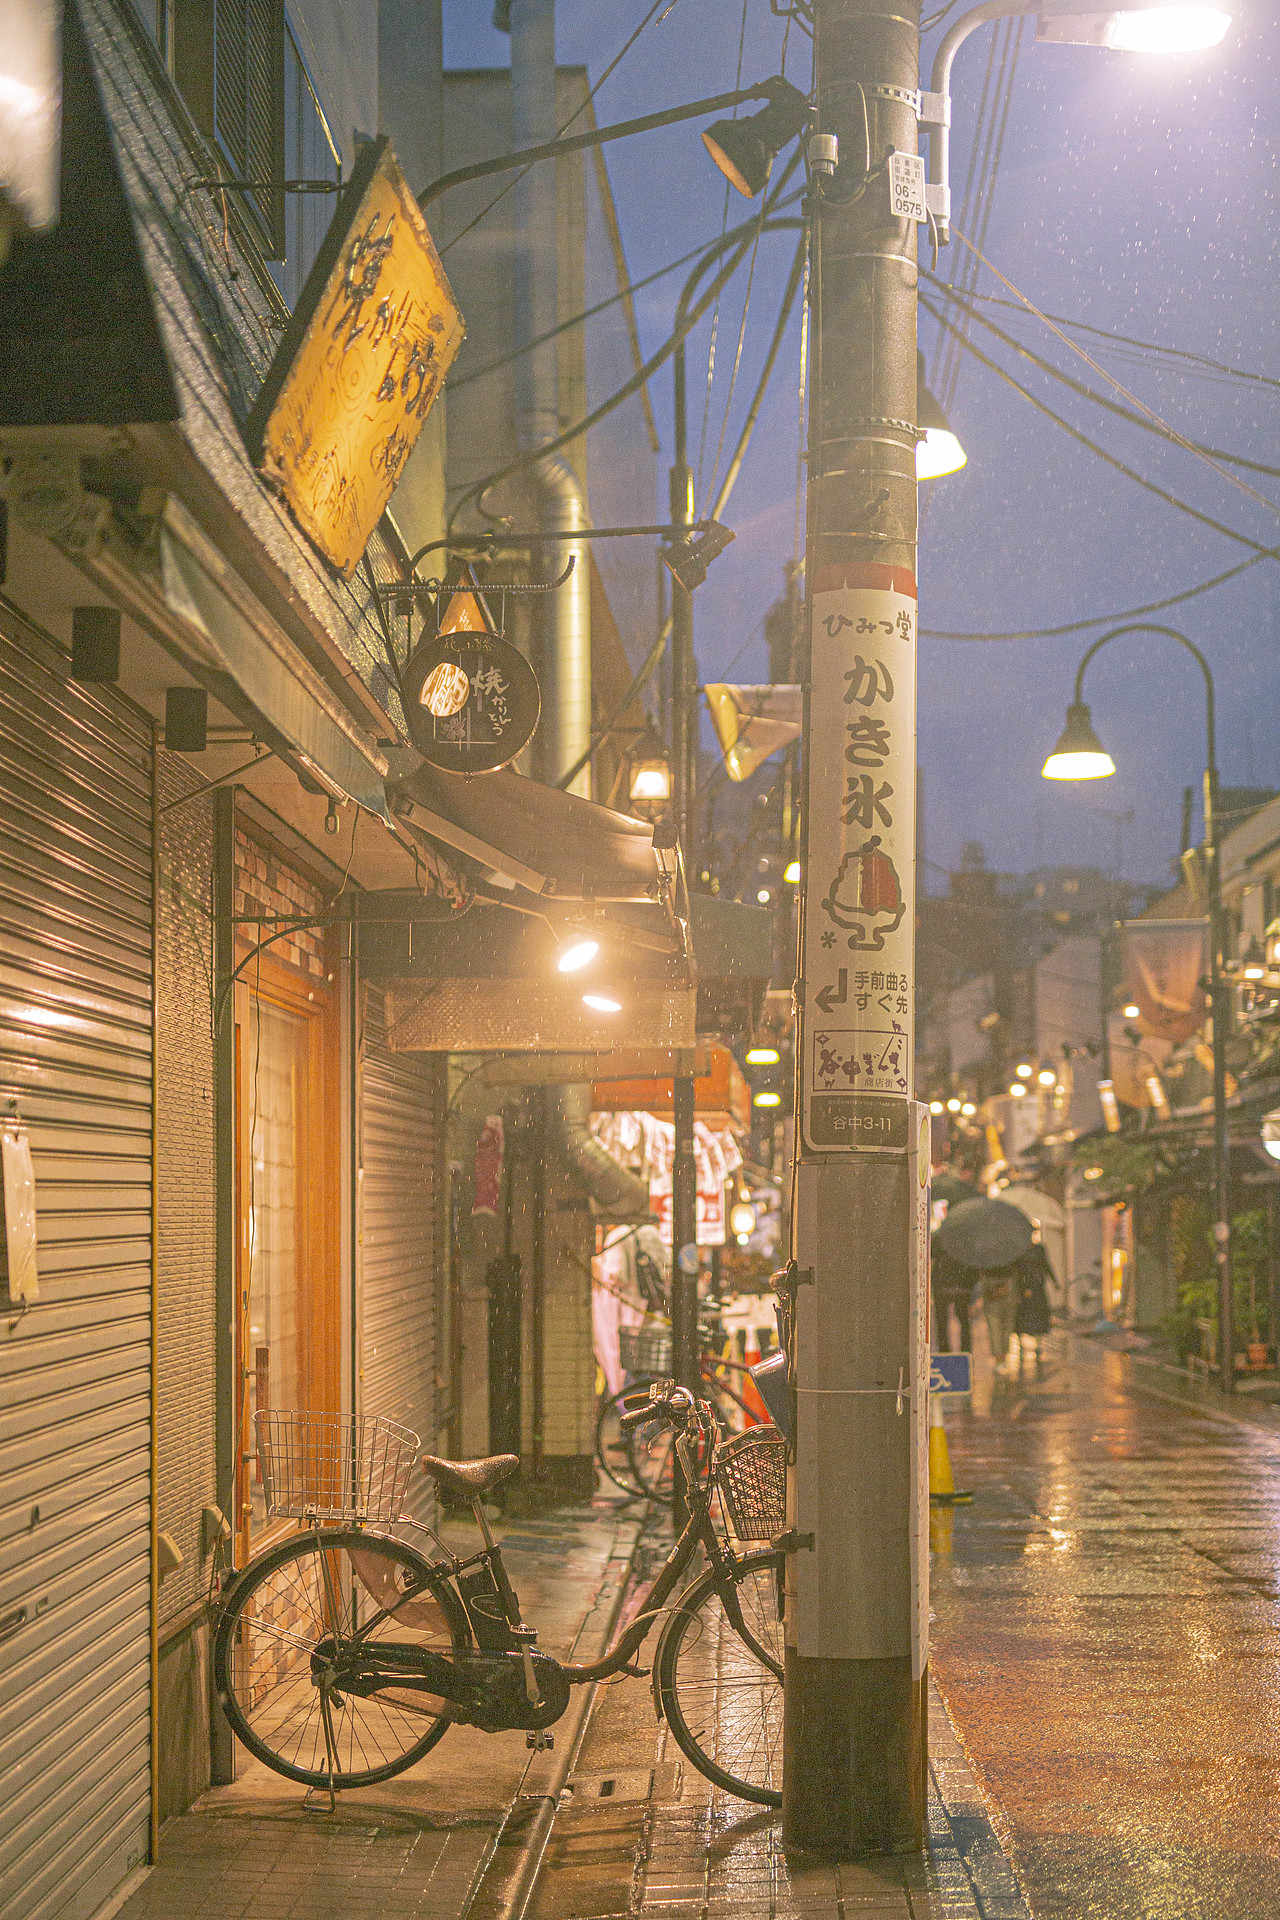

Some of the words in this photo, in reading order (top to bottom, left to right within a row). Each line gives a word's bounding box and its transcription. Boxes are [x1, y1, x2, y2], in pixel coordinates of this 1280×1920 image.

[895, 199, 922, 215] 0575
[821, 610, 912, 642] ひみつ堂
[839, 655, 895, 829] かき氷
[854, 970, 908, 992] 手前曲る
[854, 992, 908, 1015] すぐ先
[864, 1077, 893, 1088] 商店街
[833, 1115, 891, 1131] 谷中3-11
